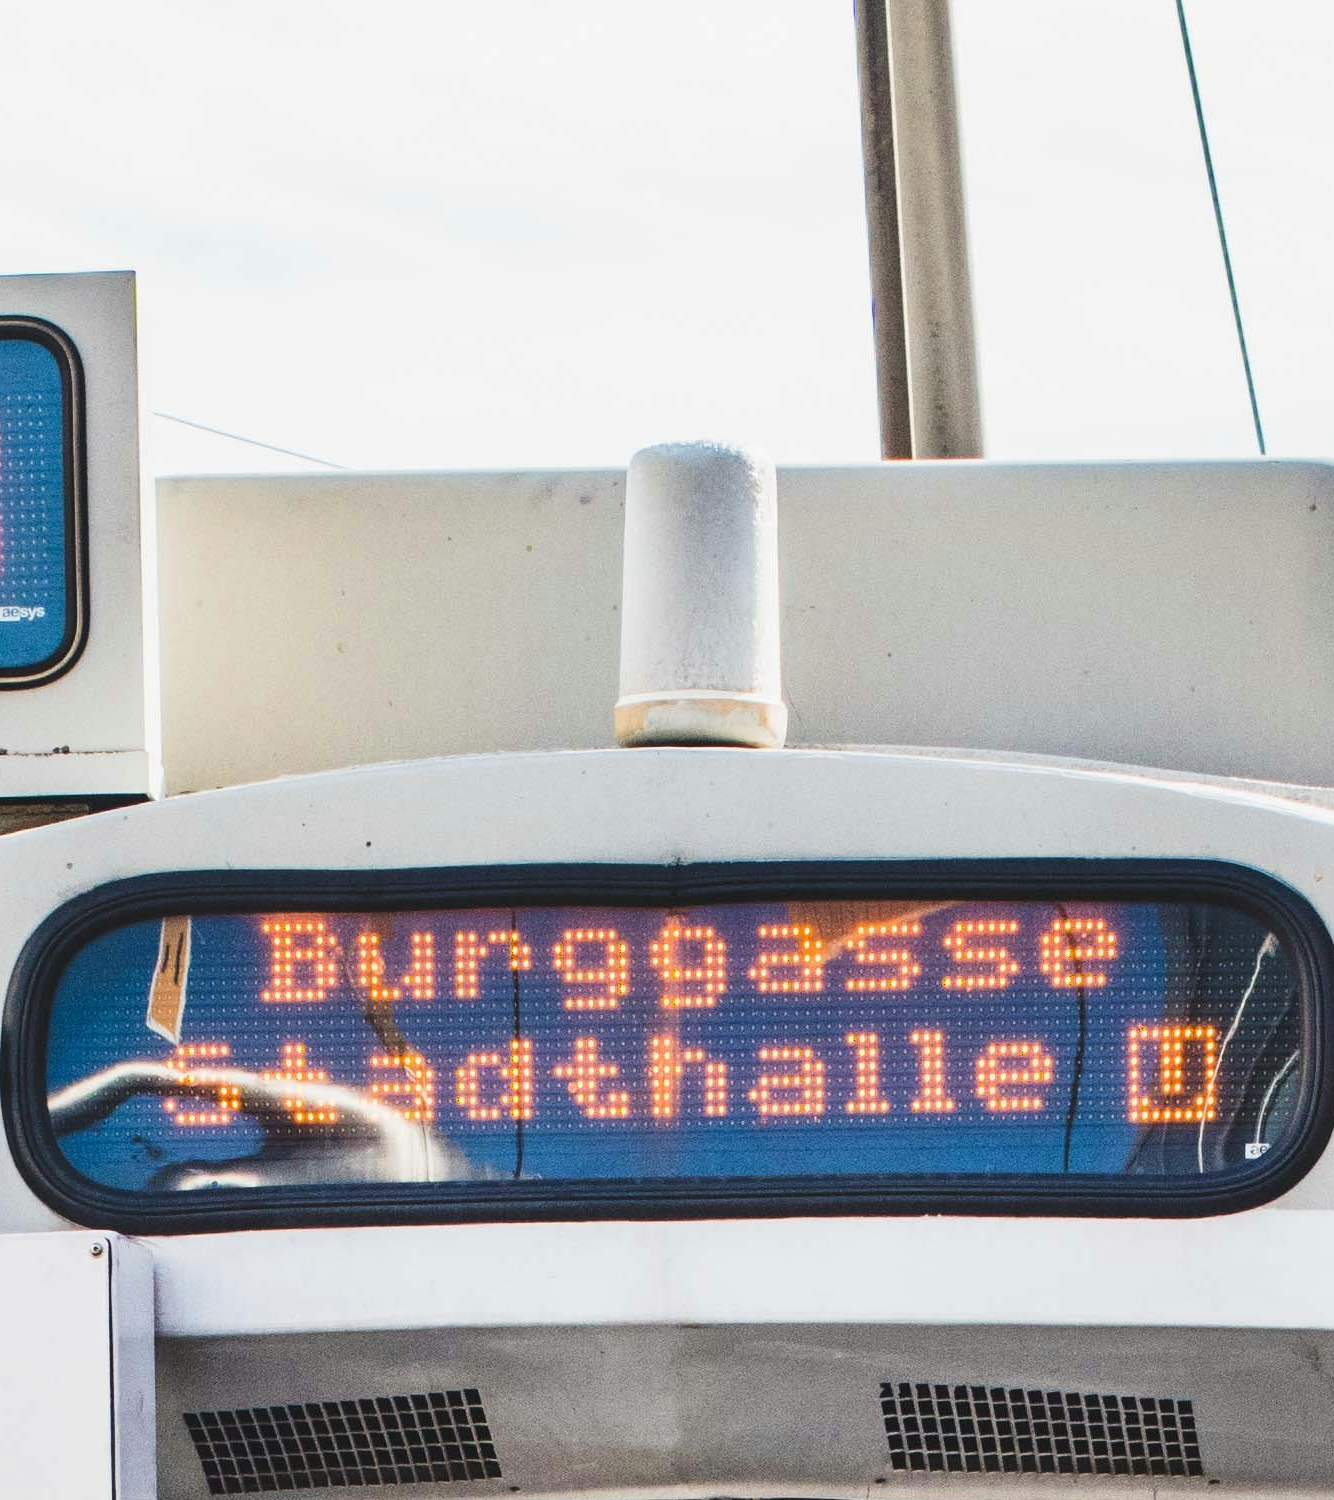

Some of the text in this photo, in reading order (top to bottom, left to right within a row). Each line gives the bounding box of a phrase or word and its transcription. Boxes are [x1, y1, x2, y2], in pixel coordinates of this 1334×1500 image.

[2, 606, 46, 621] aesys
[259, 918, 1119, 1010] Burggasse
[164, 1029, 1057, 1126] Stadthalle
